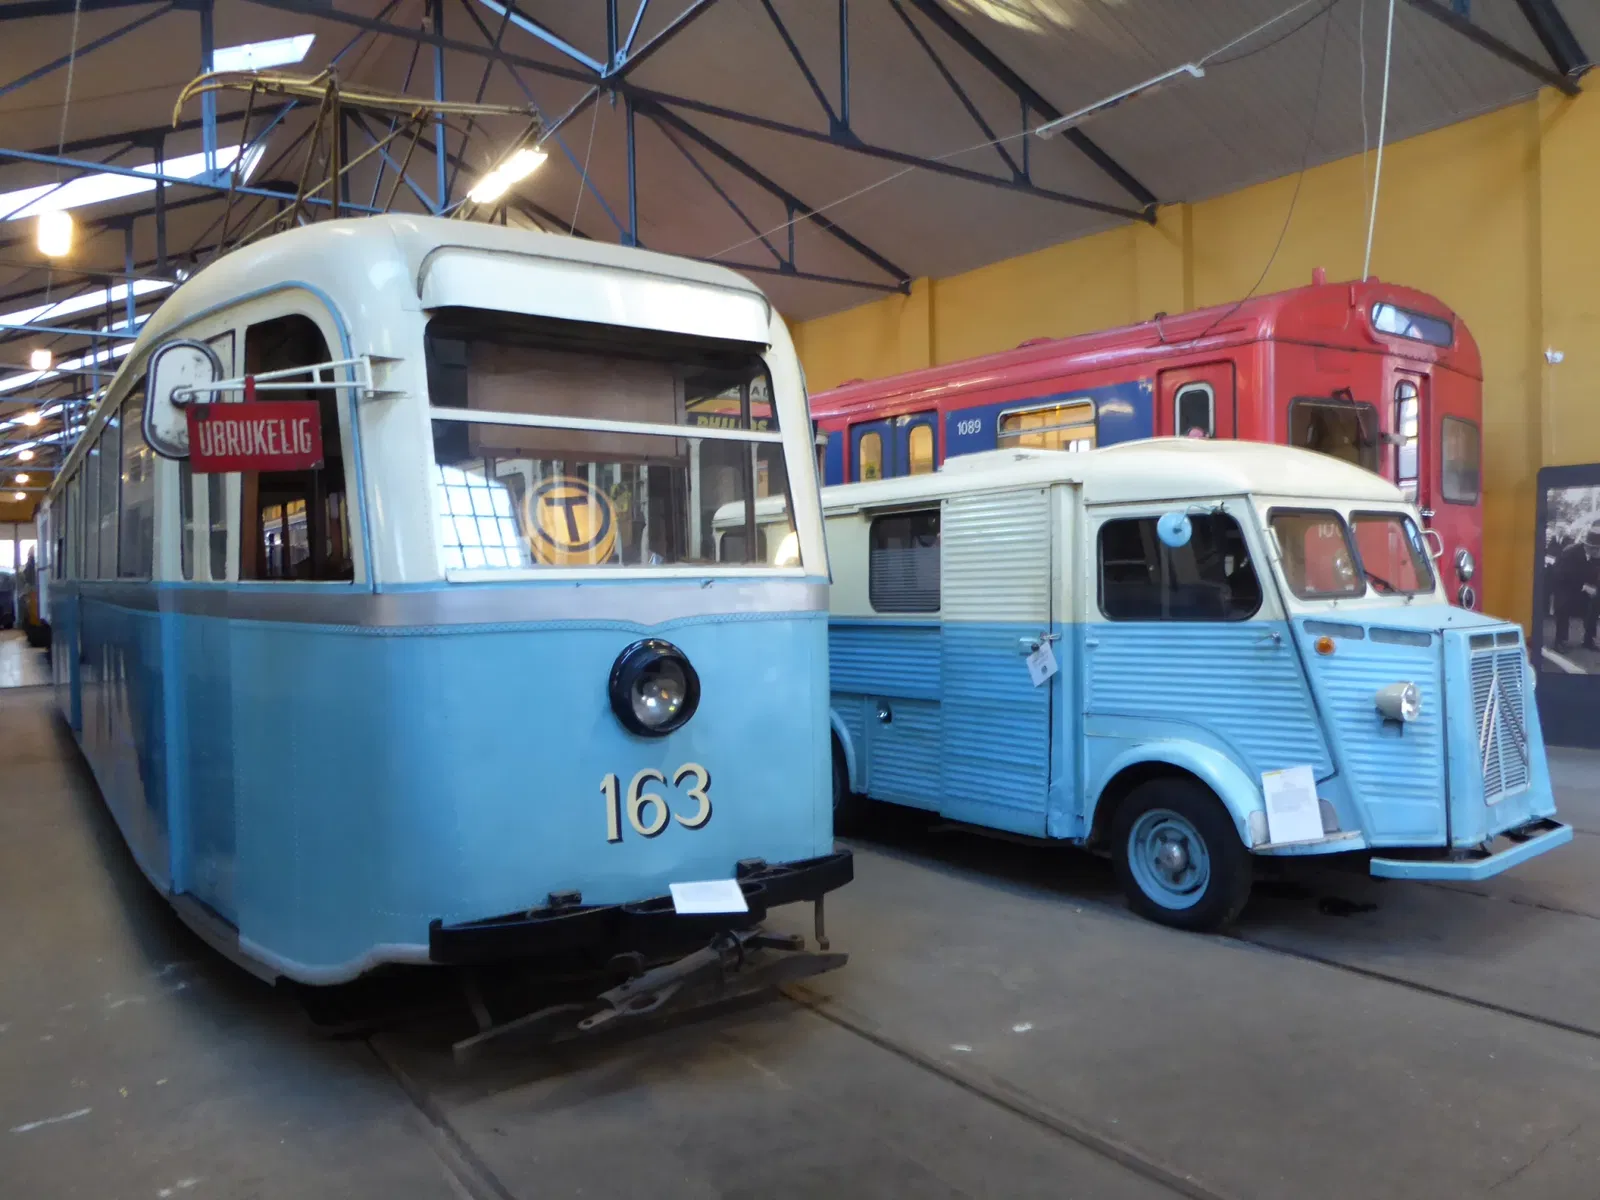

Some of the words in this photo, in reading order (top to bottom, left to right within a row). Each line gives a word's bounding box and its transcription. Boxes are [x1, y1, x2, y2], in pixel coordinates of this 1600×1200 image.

[199, 418, 312, 457] UBRUKELIG
[697, 416, 768, 431] PHILPS
[957, 419, 981, 436] 1089
[544, 495, 589, 542] T
[600, 762, 712, 844] 163
